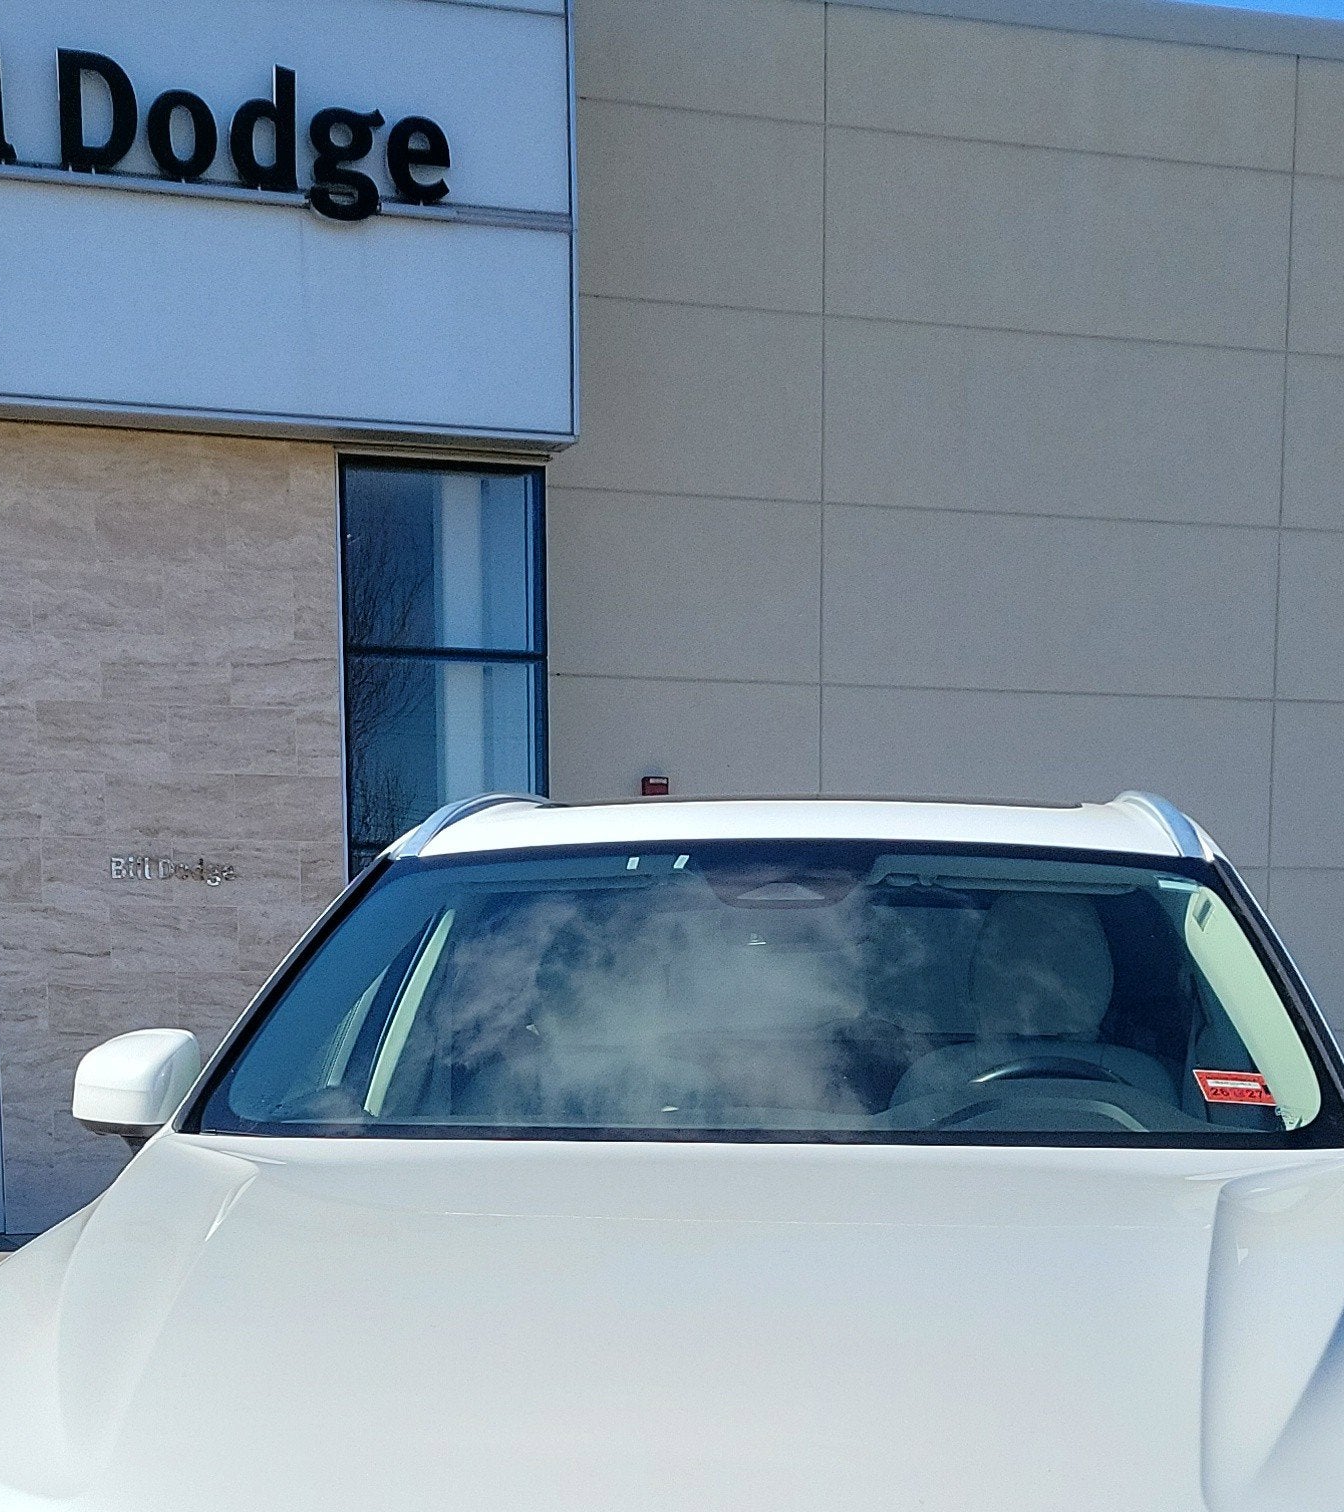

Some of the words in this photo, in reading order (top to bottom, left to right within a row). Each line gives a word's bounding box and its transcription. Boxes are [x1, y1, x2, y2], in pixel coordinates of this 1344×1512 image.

[55, 47, 451, 221] Dodge
[110, 856, 152, 880] Bill
[158, 857, 237, 887] Dodge
